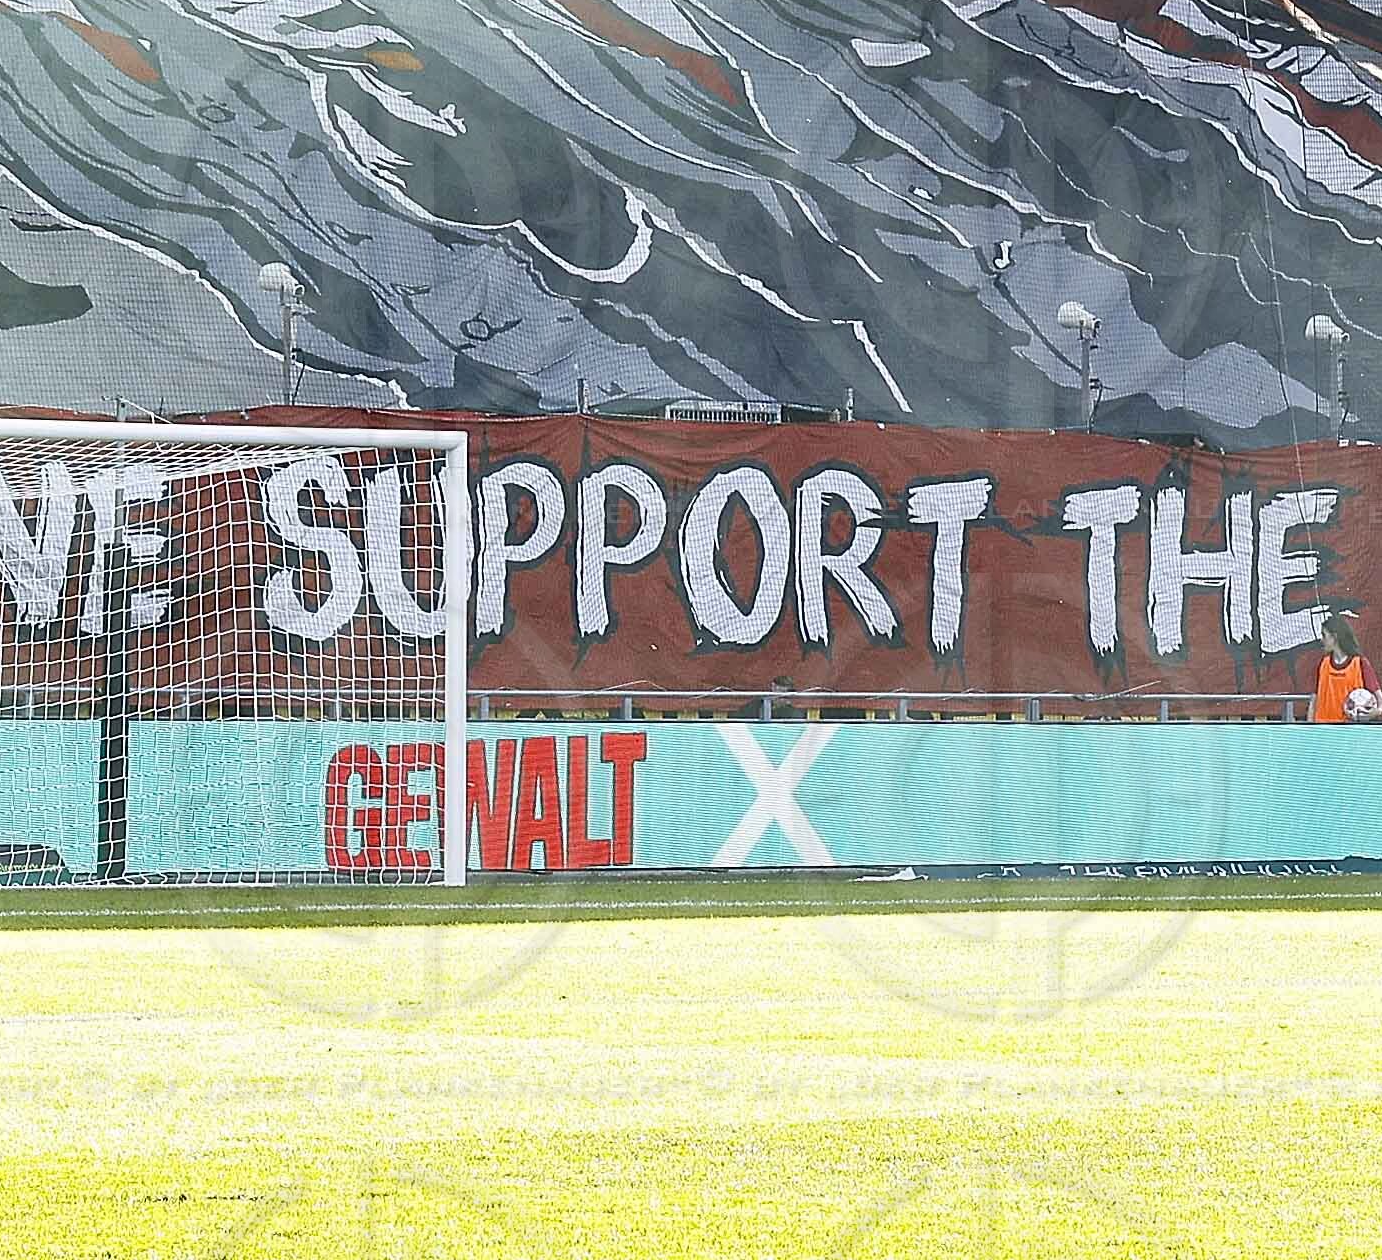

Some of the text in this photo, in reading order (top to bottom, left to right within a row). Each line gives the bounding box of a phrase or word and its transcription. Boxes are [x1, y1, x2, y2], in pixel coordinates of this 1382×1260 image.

[264, 453, 993, 652] SUPPORT
[1062, 485, 1339, 656] THE
[325, 732, 647, 871] GEWALT
